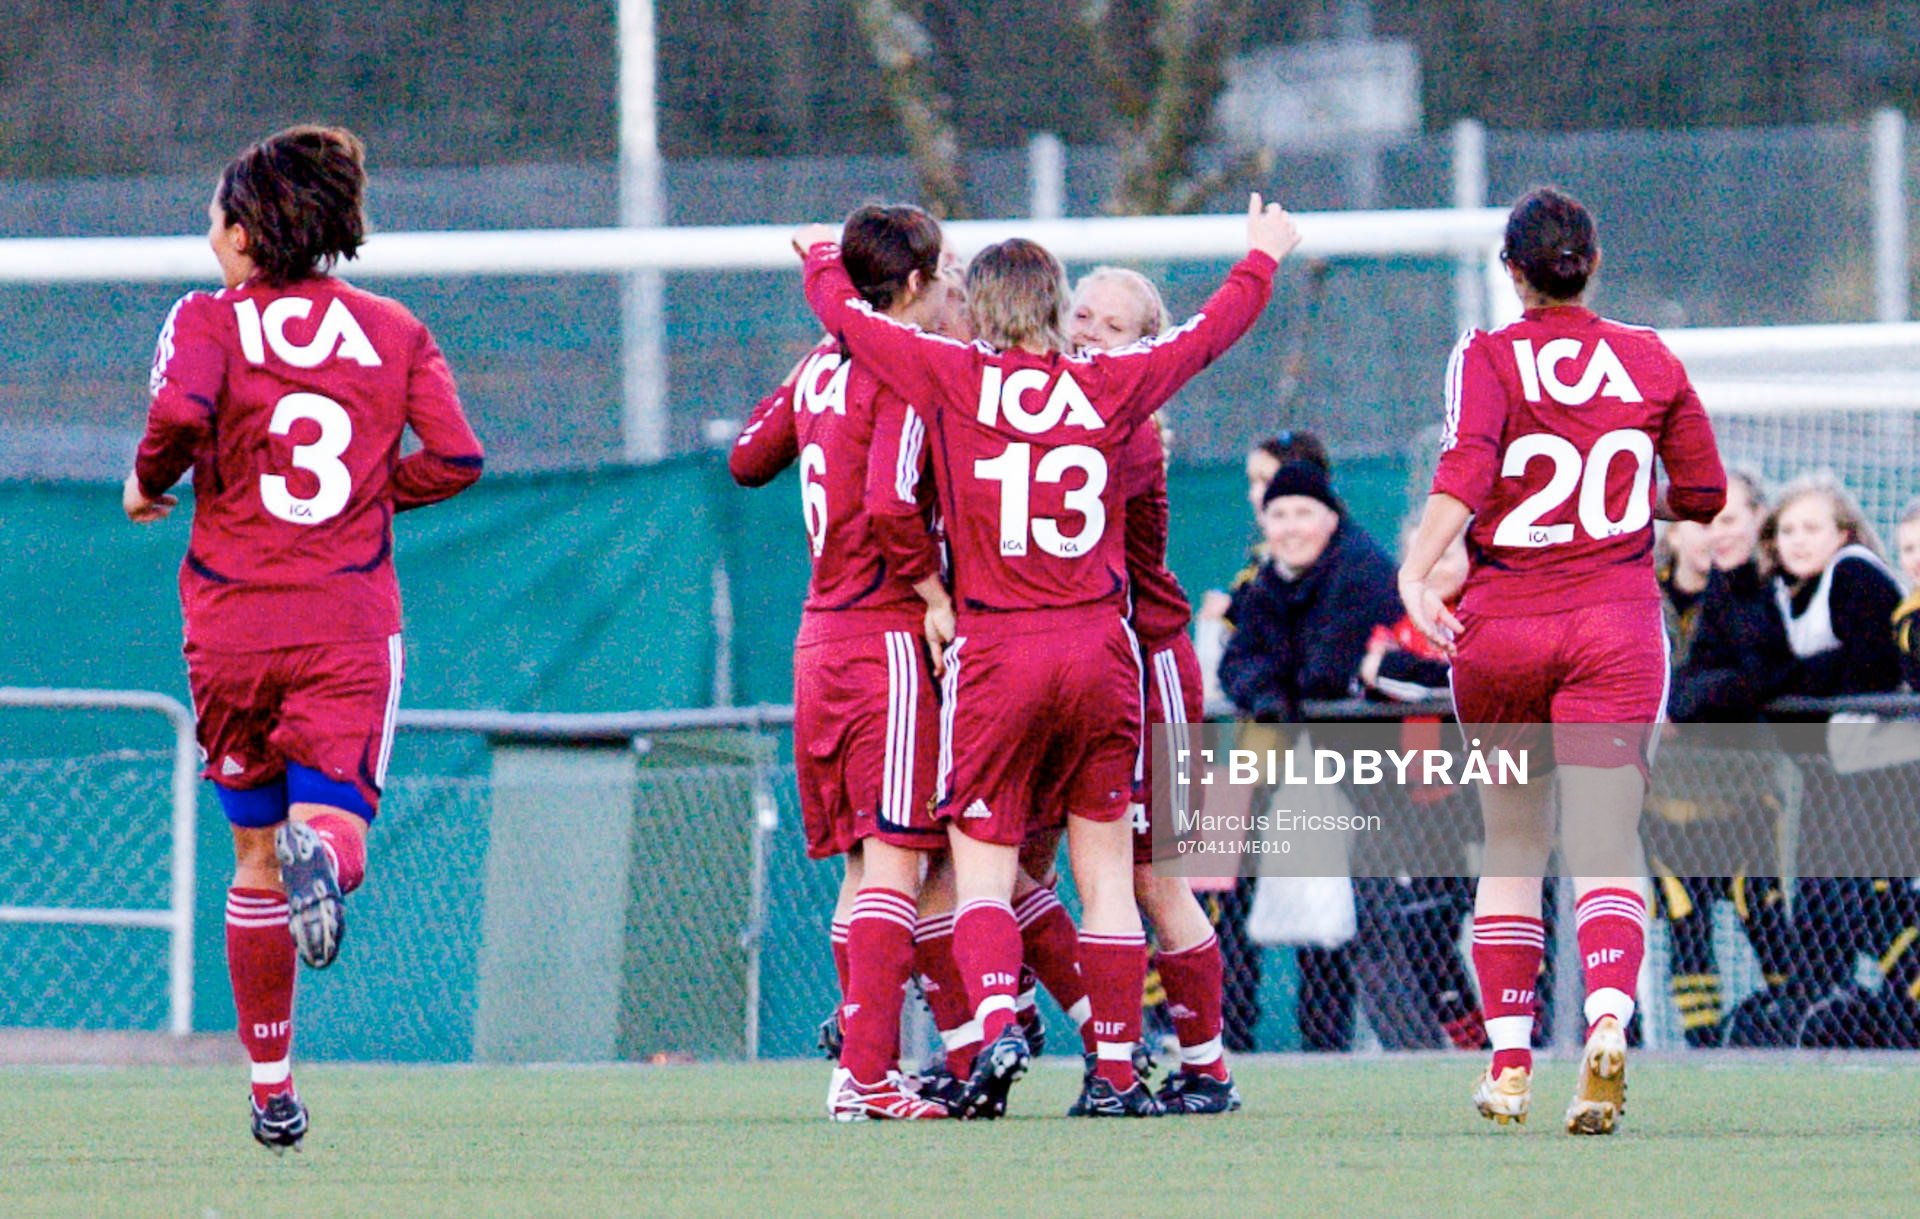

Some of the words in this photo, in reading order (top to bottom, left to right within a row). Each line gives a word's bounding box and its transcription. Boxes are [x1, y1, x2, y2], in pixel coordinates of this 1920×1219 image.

[233, 297, 382, 368] ICA
[793, 353, 852, 415] ICA
[977, 365, 1105, 434] ICA
[1511, 338, 1644, 405] ICA
[260, 392, 352, 525] 3
[1493, 428, 1654, 547] 20
[289, 503, 313, 518] ICA
[800, 442, 828, 557] 6
[974, 442, 1108, 558] 13
[1003, 540, 1023, 550] ICA
[1060, 542, 1079, 552] ICA
[1586, 948, 1625, 968] DIF
[253, 1020, 290, 1038] DIF
[1094, 1021, 1126, 1035] DIF
